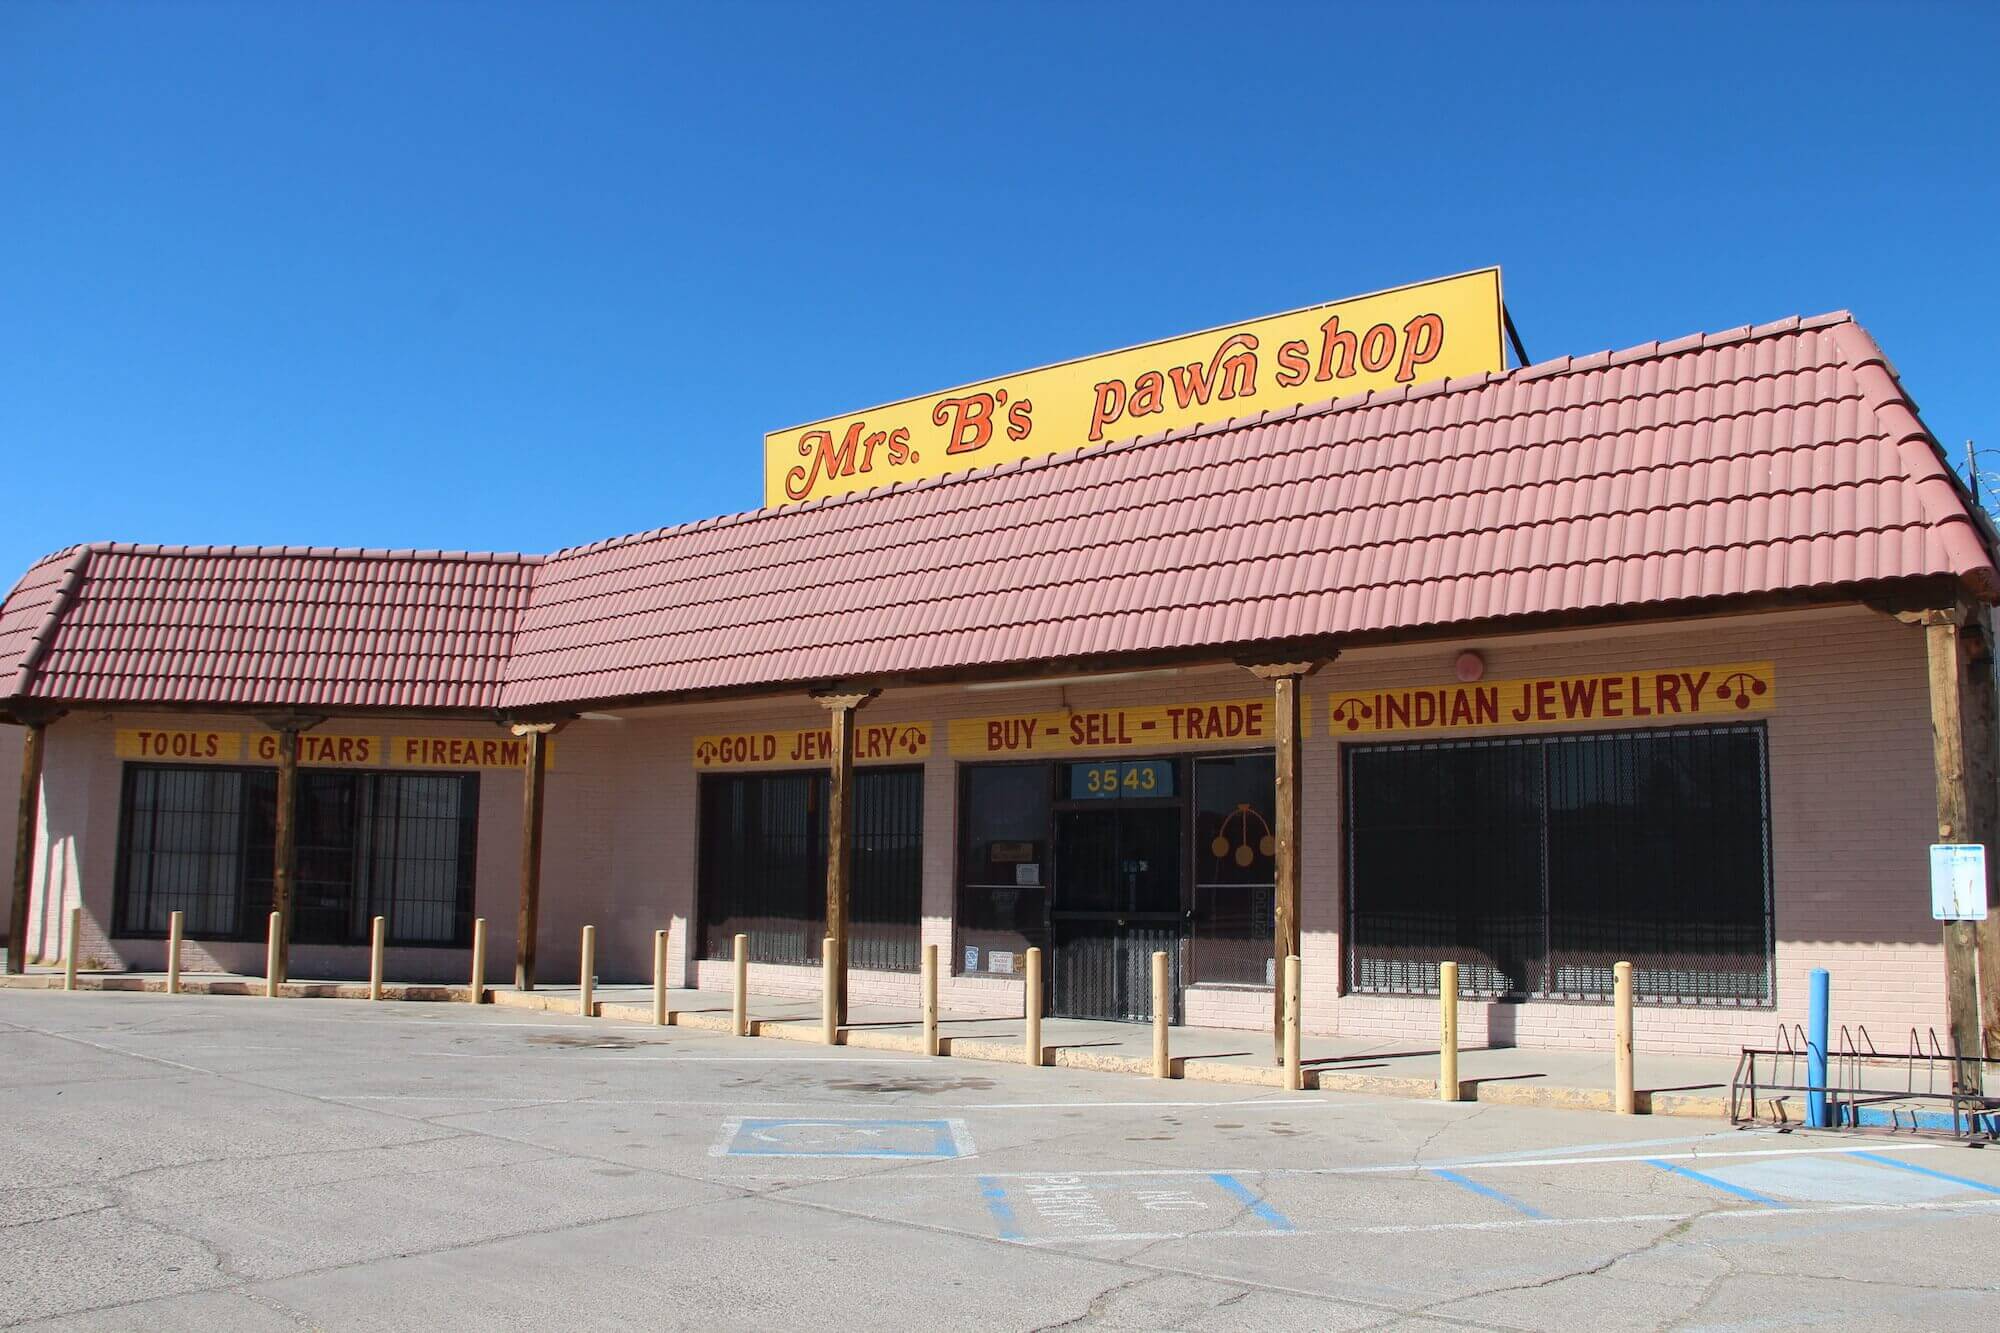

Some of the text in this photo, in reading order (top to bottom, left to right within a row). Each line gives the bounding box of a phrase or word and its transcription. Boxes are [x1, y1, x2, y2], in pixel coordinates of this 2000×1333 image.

[785, 313, 1445, 500] Mrs. B's pawn shop
[1374, 671, 1711, 730] INDIAN JEWELRY
[138, 731, 219, 758] TOOLS
[719, 726, 898, 764] GOLD JEWLRY
[987, 717, 1038, 751] BUY
[1069, 711, 1133, 746] SELL
[1167, 703, 1264, 740] TRADE
[258, 735, 370, 763] GITARS
[1087, 767, 1157, 793] 3543
